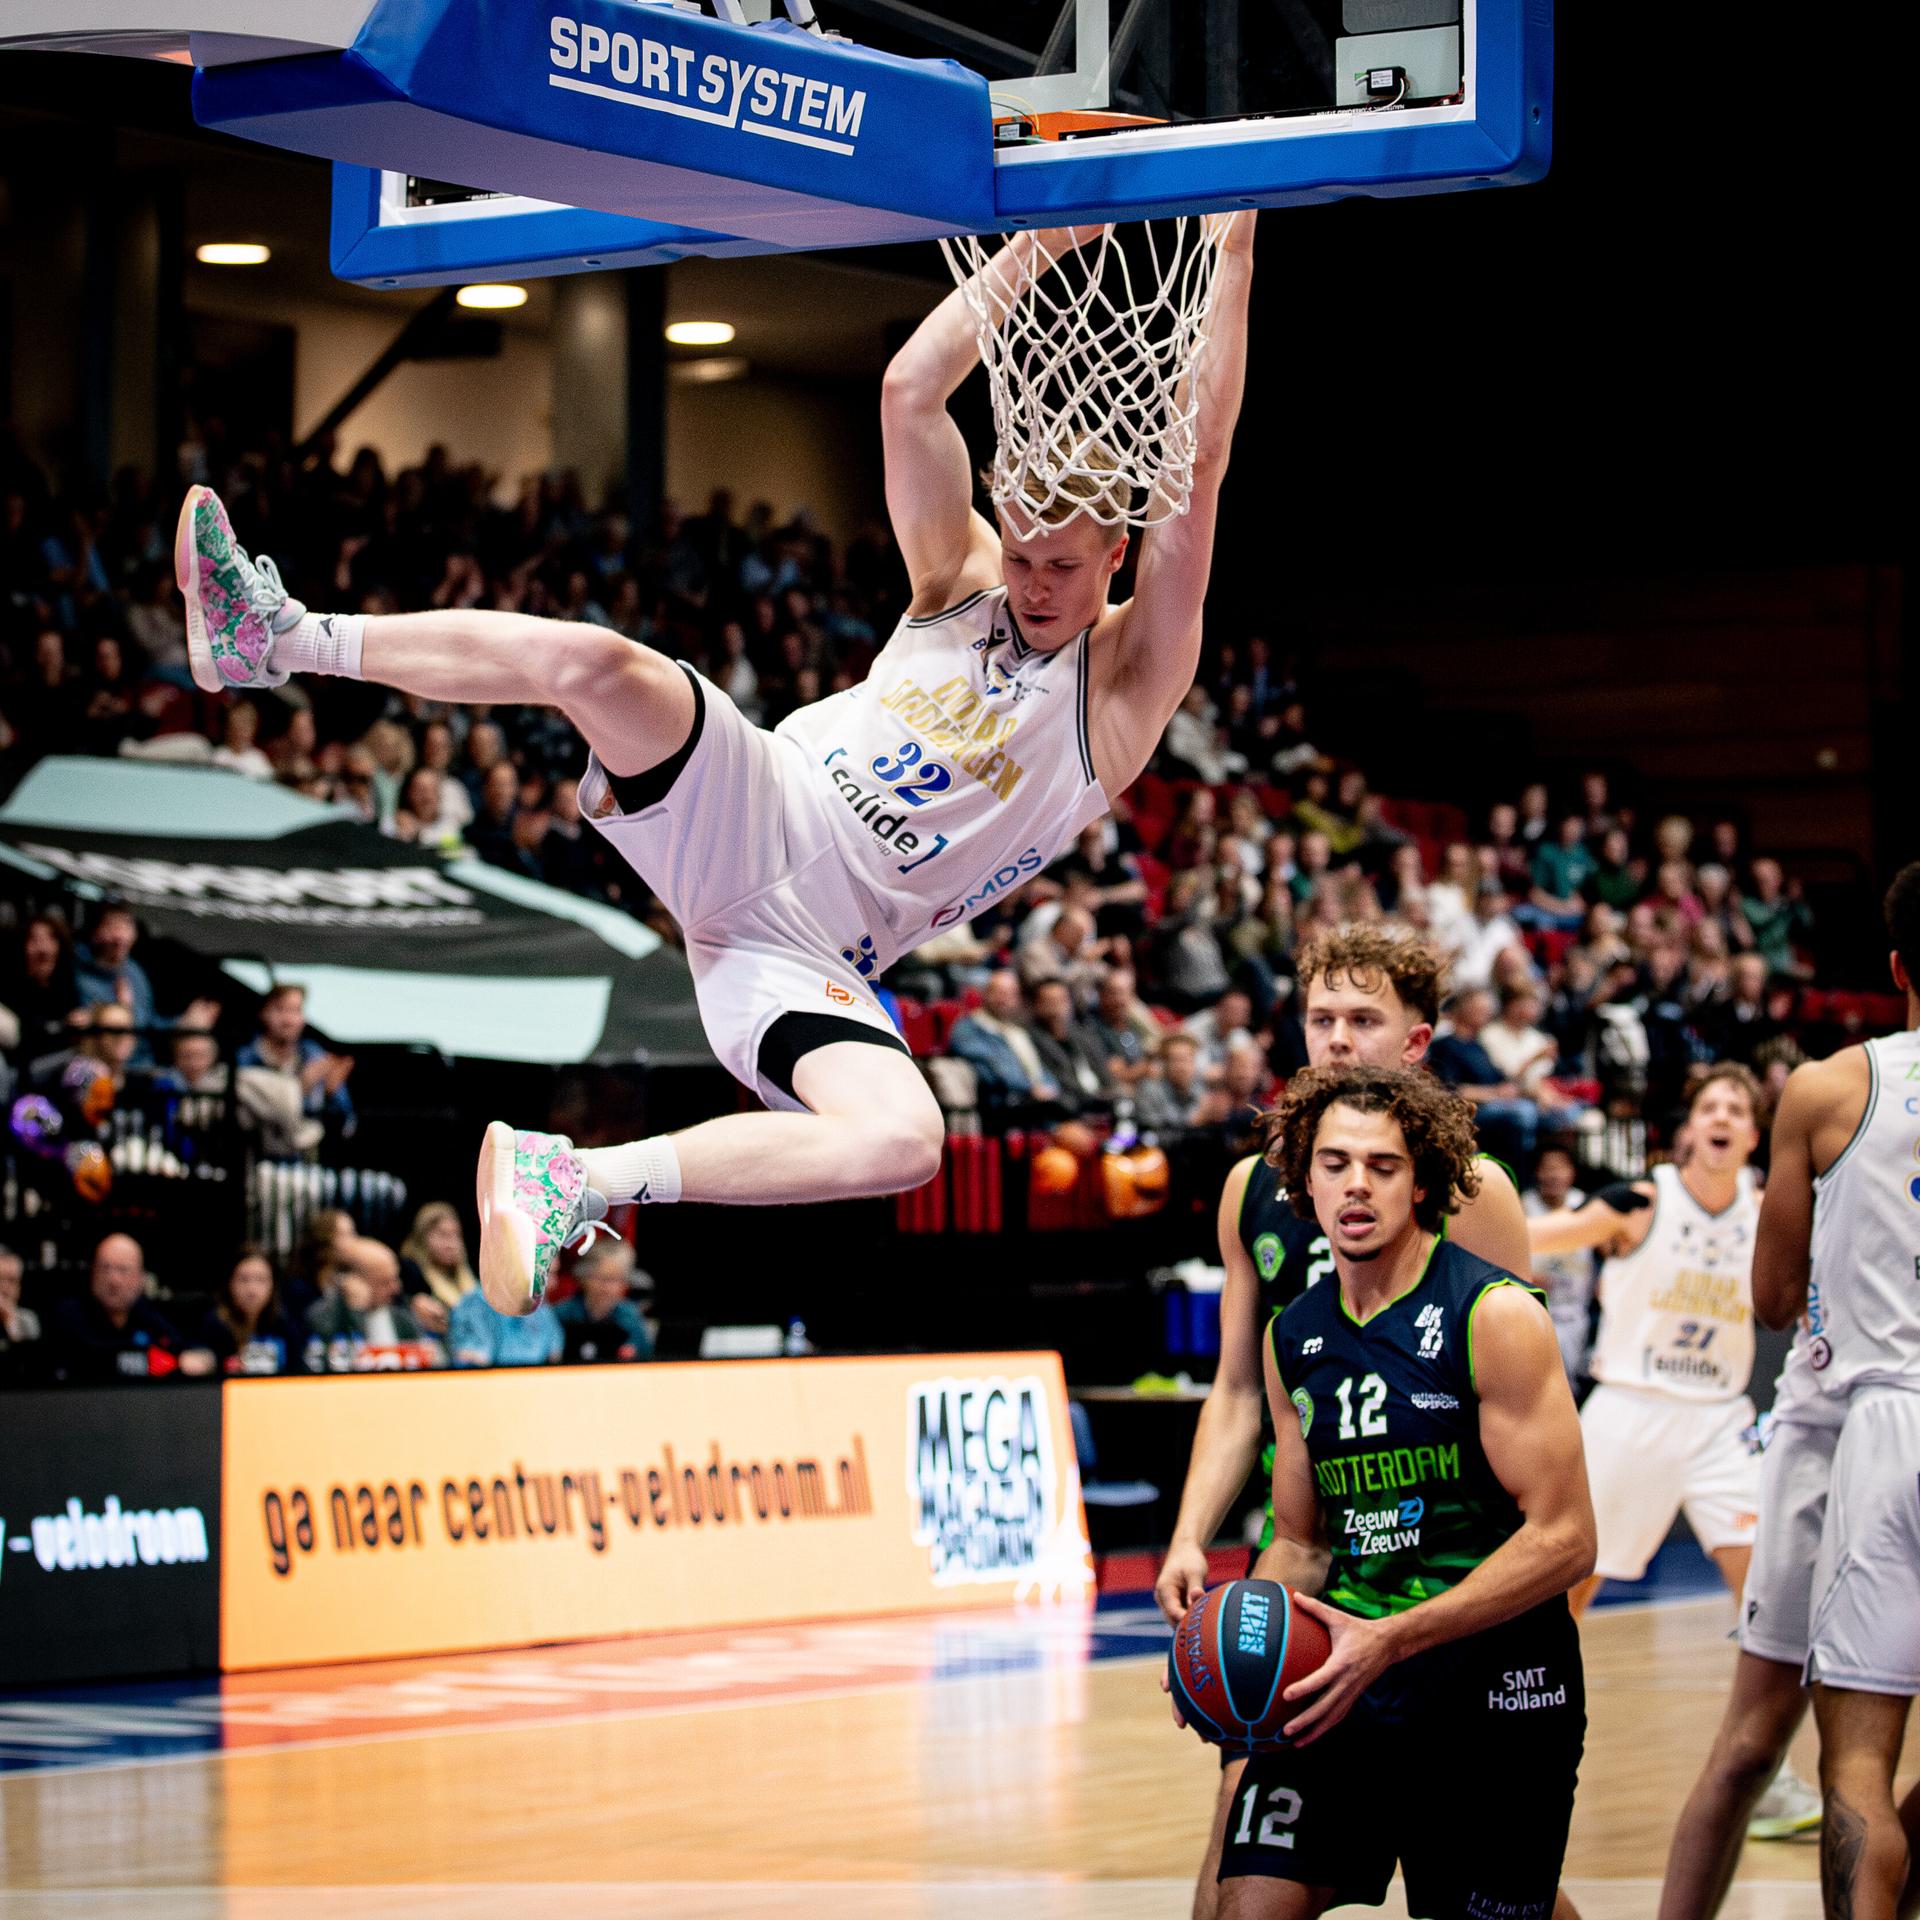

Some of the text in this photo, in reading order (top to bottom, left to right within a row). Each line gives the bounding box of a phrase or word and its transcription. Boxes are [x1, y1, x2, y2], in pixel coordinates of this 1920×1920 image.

[879, 679, 1024, 802] GROGEN
[932, 674, 1019, 749] DOAR
[870, 740, 953, 809] 32
[917, 1388, 1040, 1475] MEGA
[1335, 1373, 1388, 1440] 12
[264, 1489, 314, 1576] ga
[331, 1483, 424, 1549] naar
[443, 1433, 873, 1553] century-velodroom.nl
[1344, 1506, 1399, 1534] Zeeuw
[1488, 1686, 1566, 1711] Holland
[1502, 1667, 1547, 1691] SMT
[1234, 1783, 1302, 1850] 12
